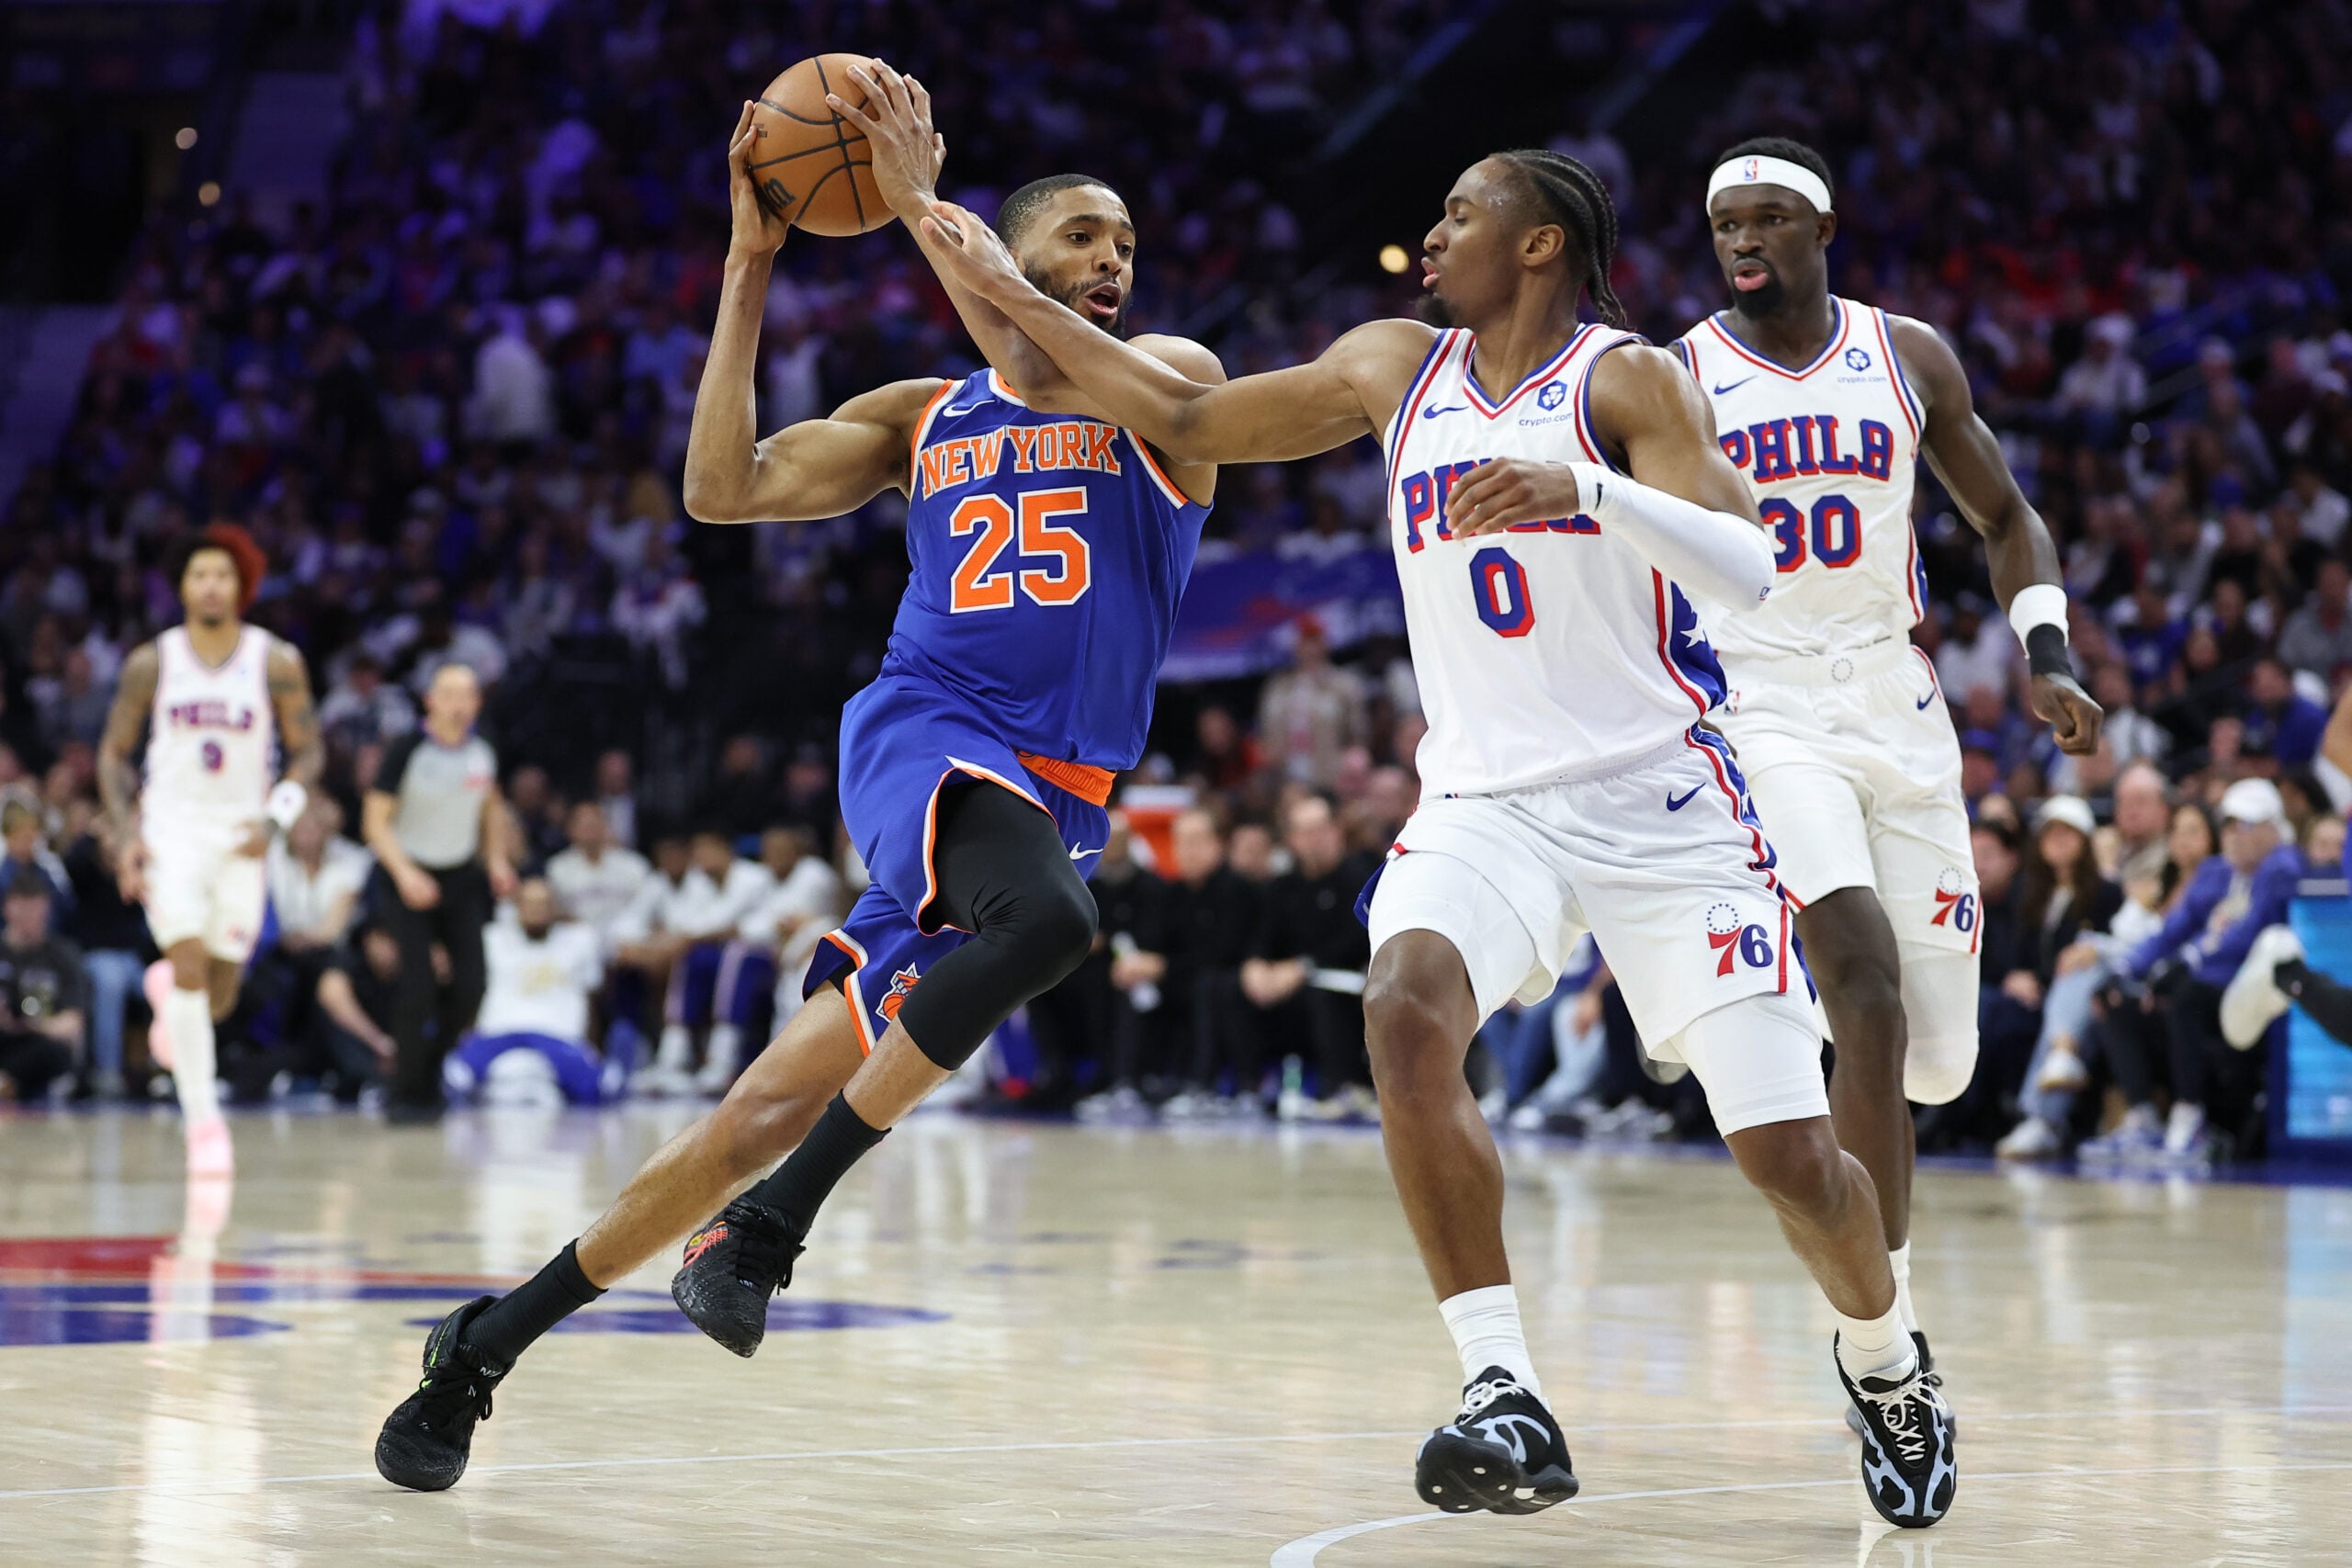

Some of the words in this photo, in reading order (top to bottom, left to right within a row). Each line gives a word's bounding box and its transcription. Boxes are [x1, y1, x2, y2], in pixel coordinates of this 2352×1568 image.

[1519, 412, 1574, 427] crypto.com
[1719, 415, 1894, 484] PHILA
[920, 425, 1005, 502] NEW
[1006, 421, 1121, 477] YORK
[949, 486, 1091, 614] 25
[1758, 494, 1861, 572] 30
[1469, 547, 1535, 637] 0
[1930, 887, 1974, 932] 76
[1707, 924, 1774, 977] 76
